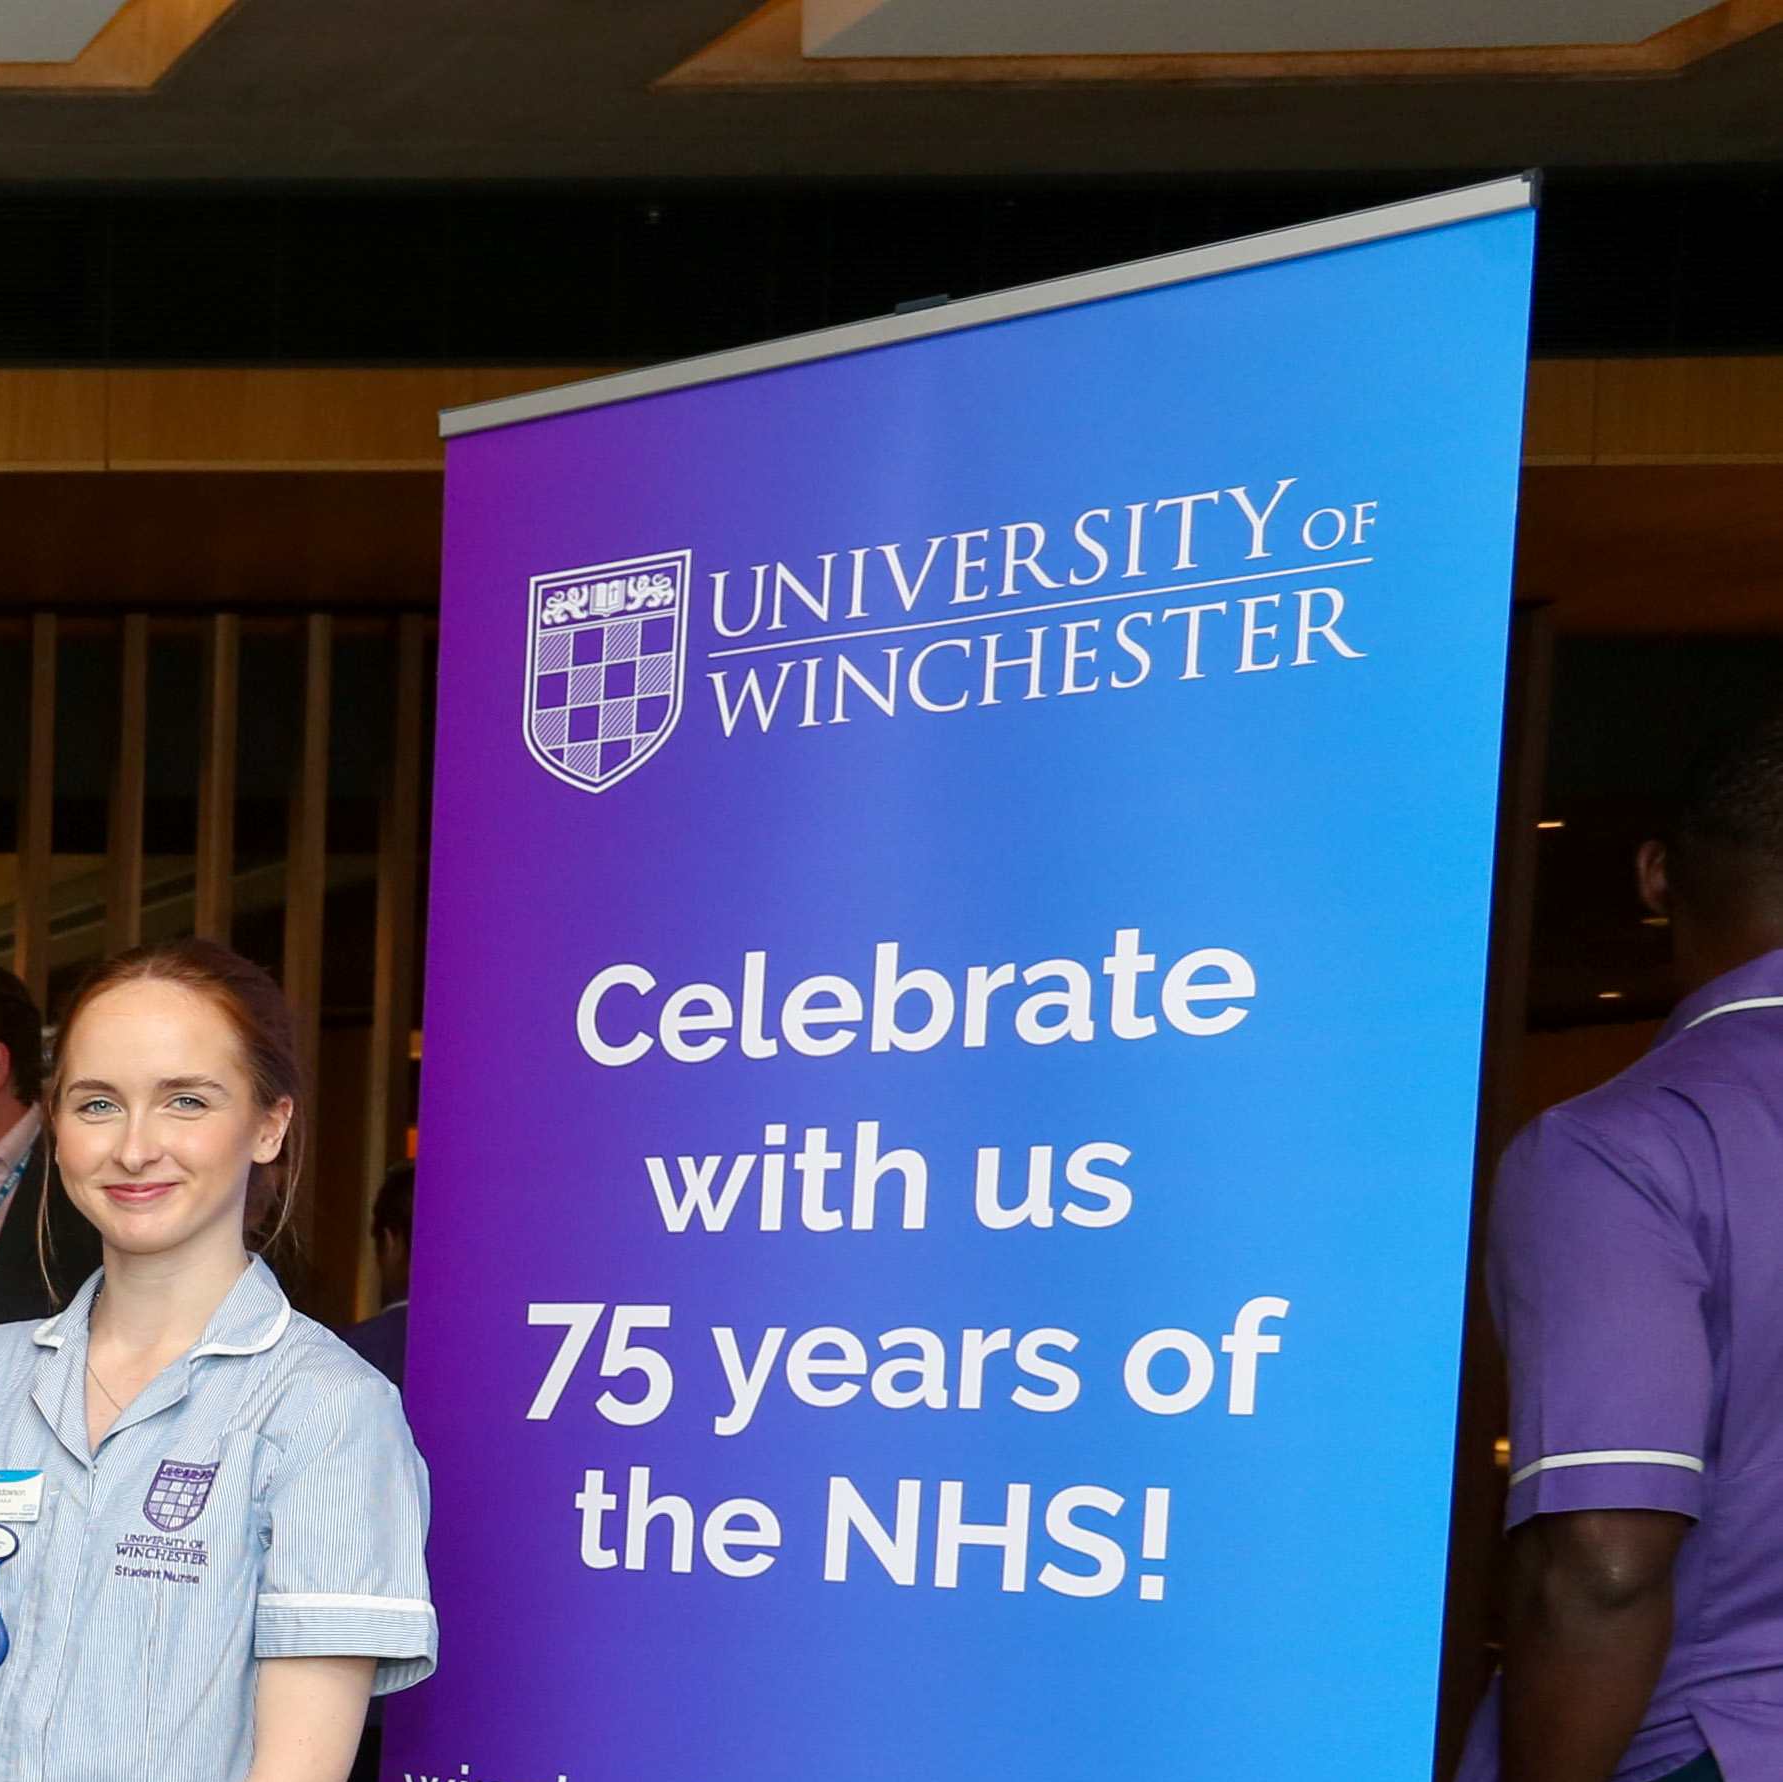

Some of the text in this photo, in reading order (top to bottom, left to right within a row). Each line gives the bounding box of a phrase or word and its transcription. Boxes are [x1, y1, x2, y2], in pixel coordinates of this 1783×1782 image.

[708, 477, 1378, 638] UNIVERSITY OF
[706, 586, 1367, 739] WINCHESTER
[576, 928, 1256, 1066] Celebrate
[644, 1121, 1132, 1233] with us
[526, 1296, 1290, 1436] 75 years of
[115, 1544, 208, 1567] WINCHESTER
[115, 1564, 200, 1584] Student Nurse
[124, 1533, 205, 1550] UNIVERSITY OF
[575, 1466, 1170, 1601] the NHS!
